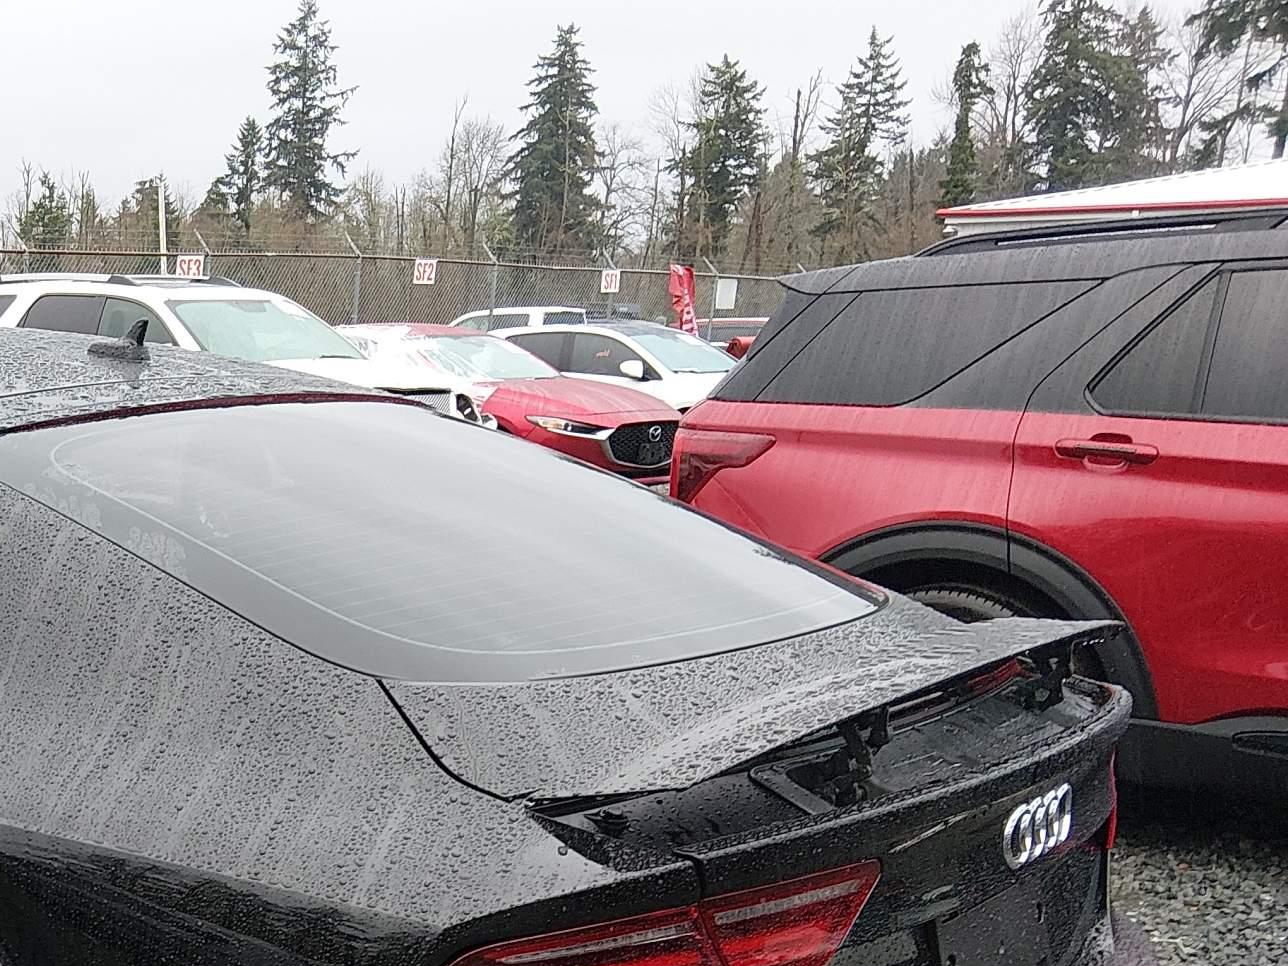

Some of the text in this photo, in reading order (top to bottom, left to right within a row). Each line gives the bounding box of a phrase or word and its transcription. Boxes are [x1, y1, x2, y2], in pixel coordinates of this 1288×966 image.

[179, 258, 201, 276] SF3
[415, 262, 434, 281] SF2
[604, 272, 617, 290] SF1
